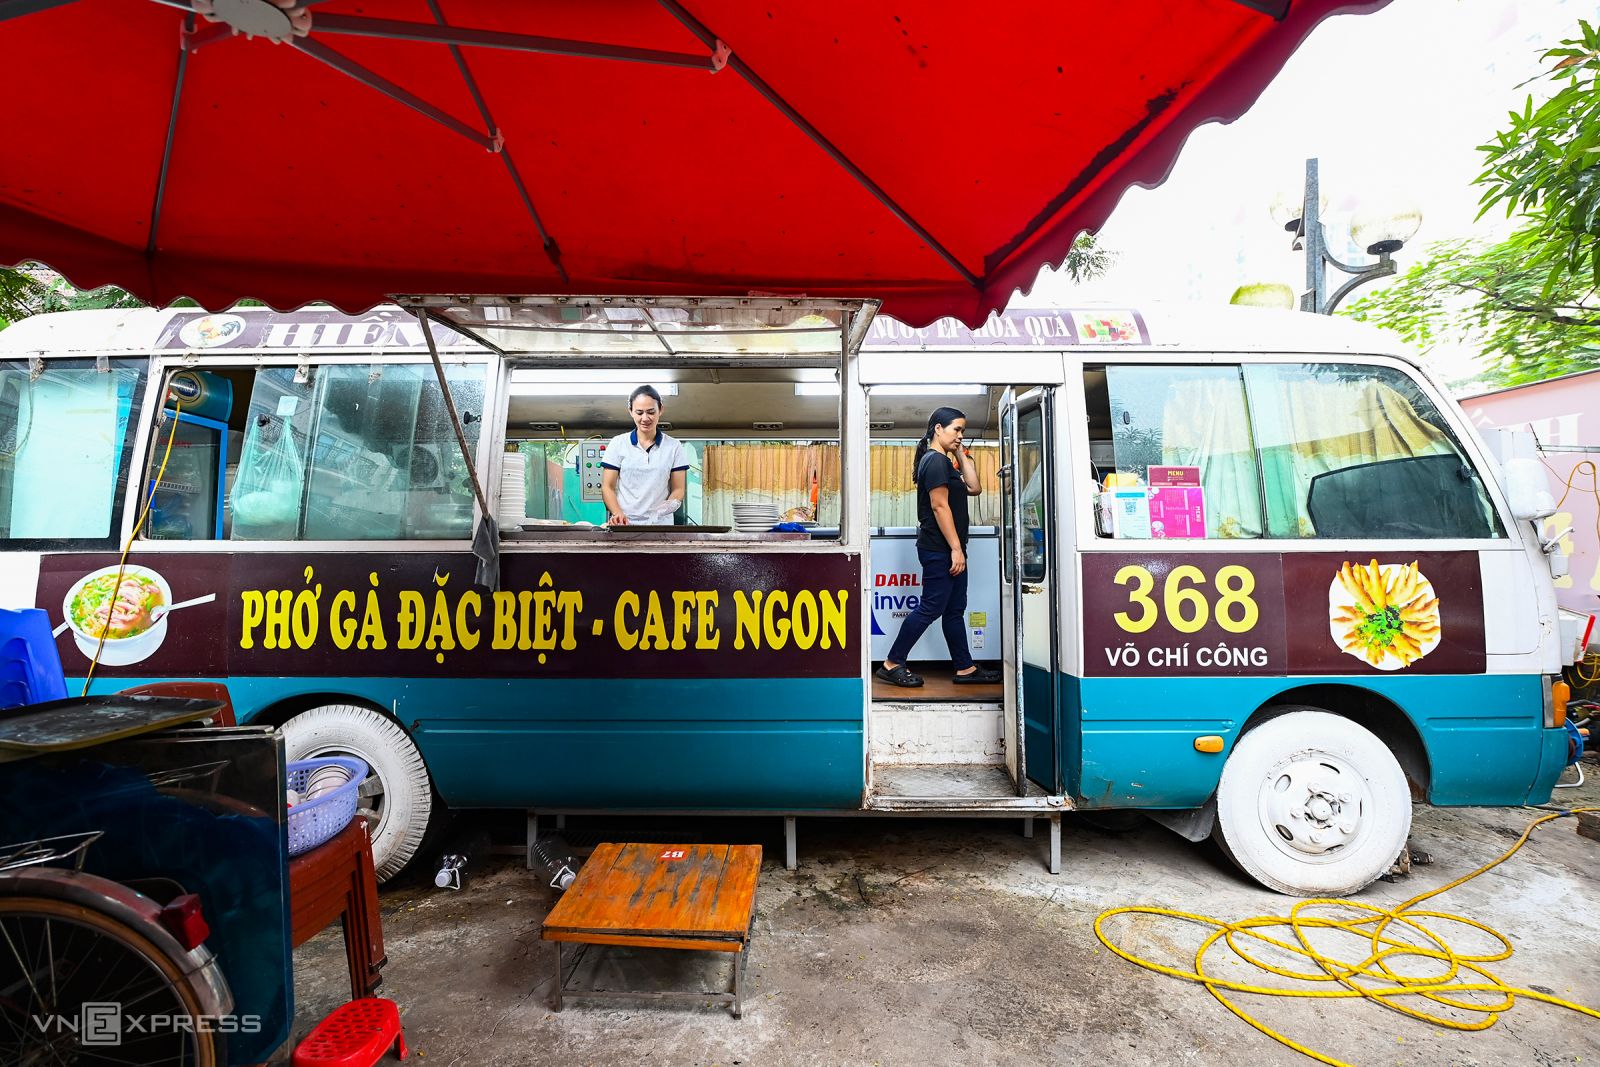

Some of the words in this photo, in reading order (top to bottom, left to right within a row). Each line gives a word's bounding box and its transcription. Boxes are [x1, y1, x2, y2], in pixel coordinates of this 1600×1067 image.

[875, 574, 925, 587] DARL
[874, 592, 920, 610] inve
[1113, 565, 1259, 634] 368
[240, 565, 322, 650] PHỞ
[330, 572, 388, 650] GÀ
[397, 572, 482, 664] ĐẶC
[492, 571, 583, 664] BIỆT
[614, 590, 720, 650] CAFE
[733, 590, 848, 650] NGON
[1105, 642, 1141, 667] VÕ
[1147, 642, 1190, 667] CHÍ
[1196, 642, 1268, 667] CÔNG
